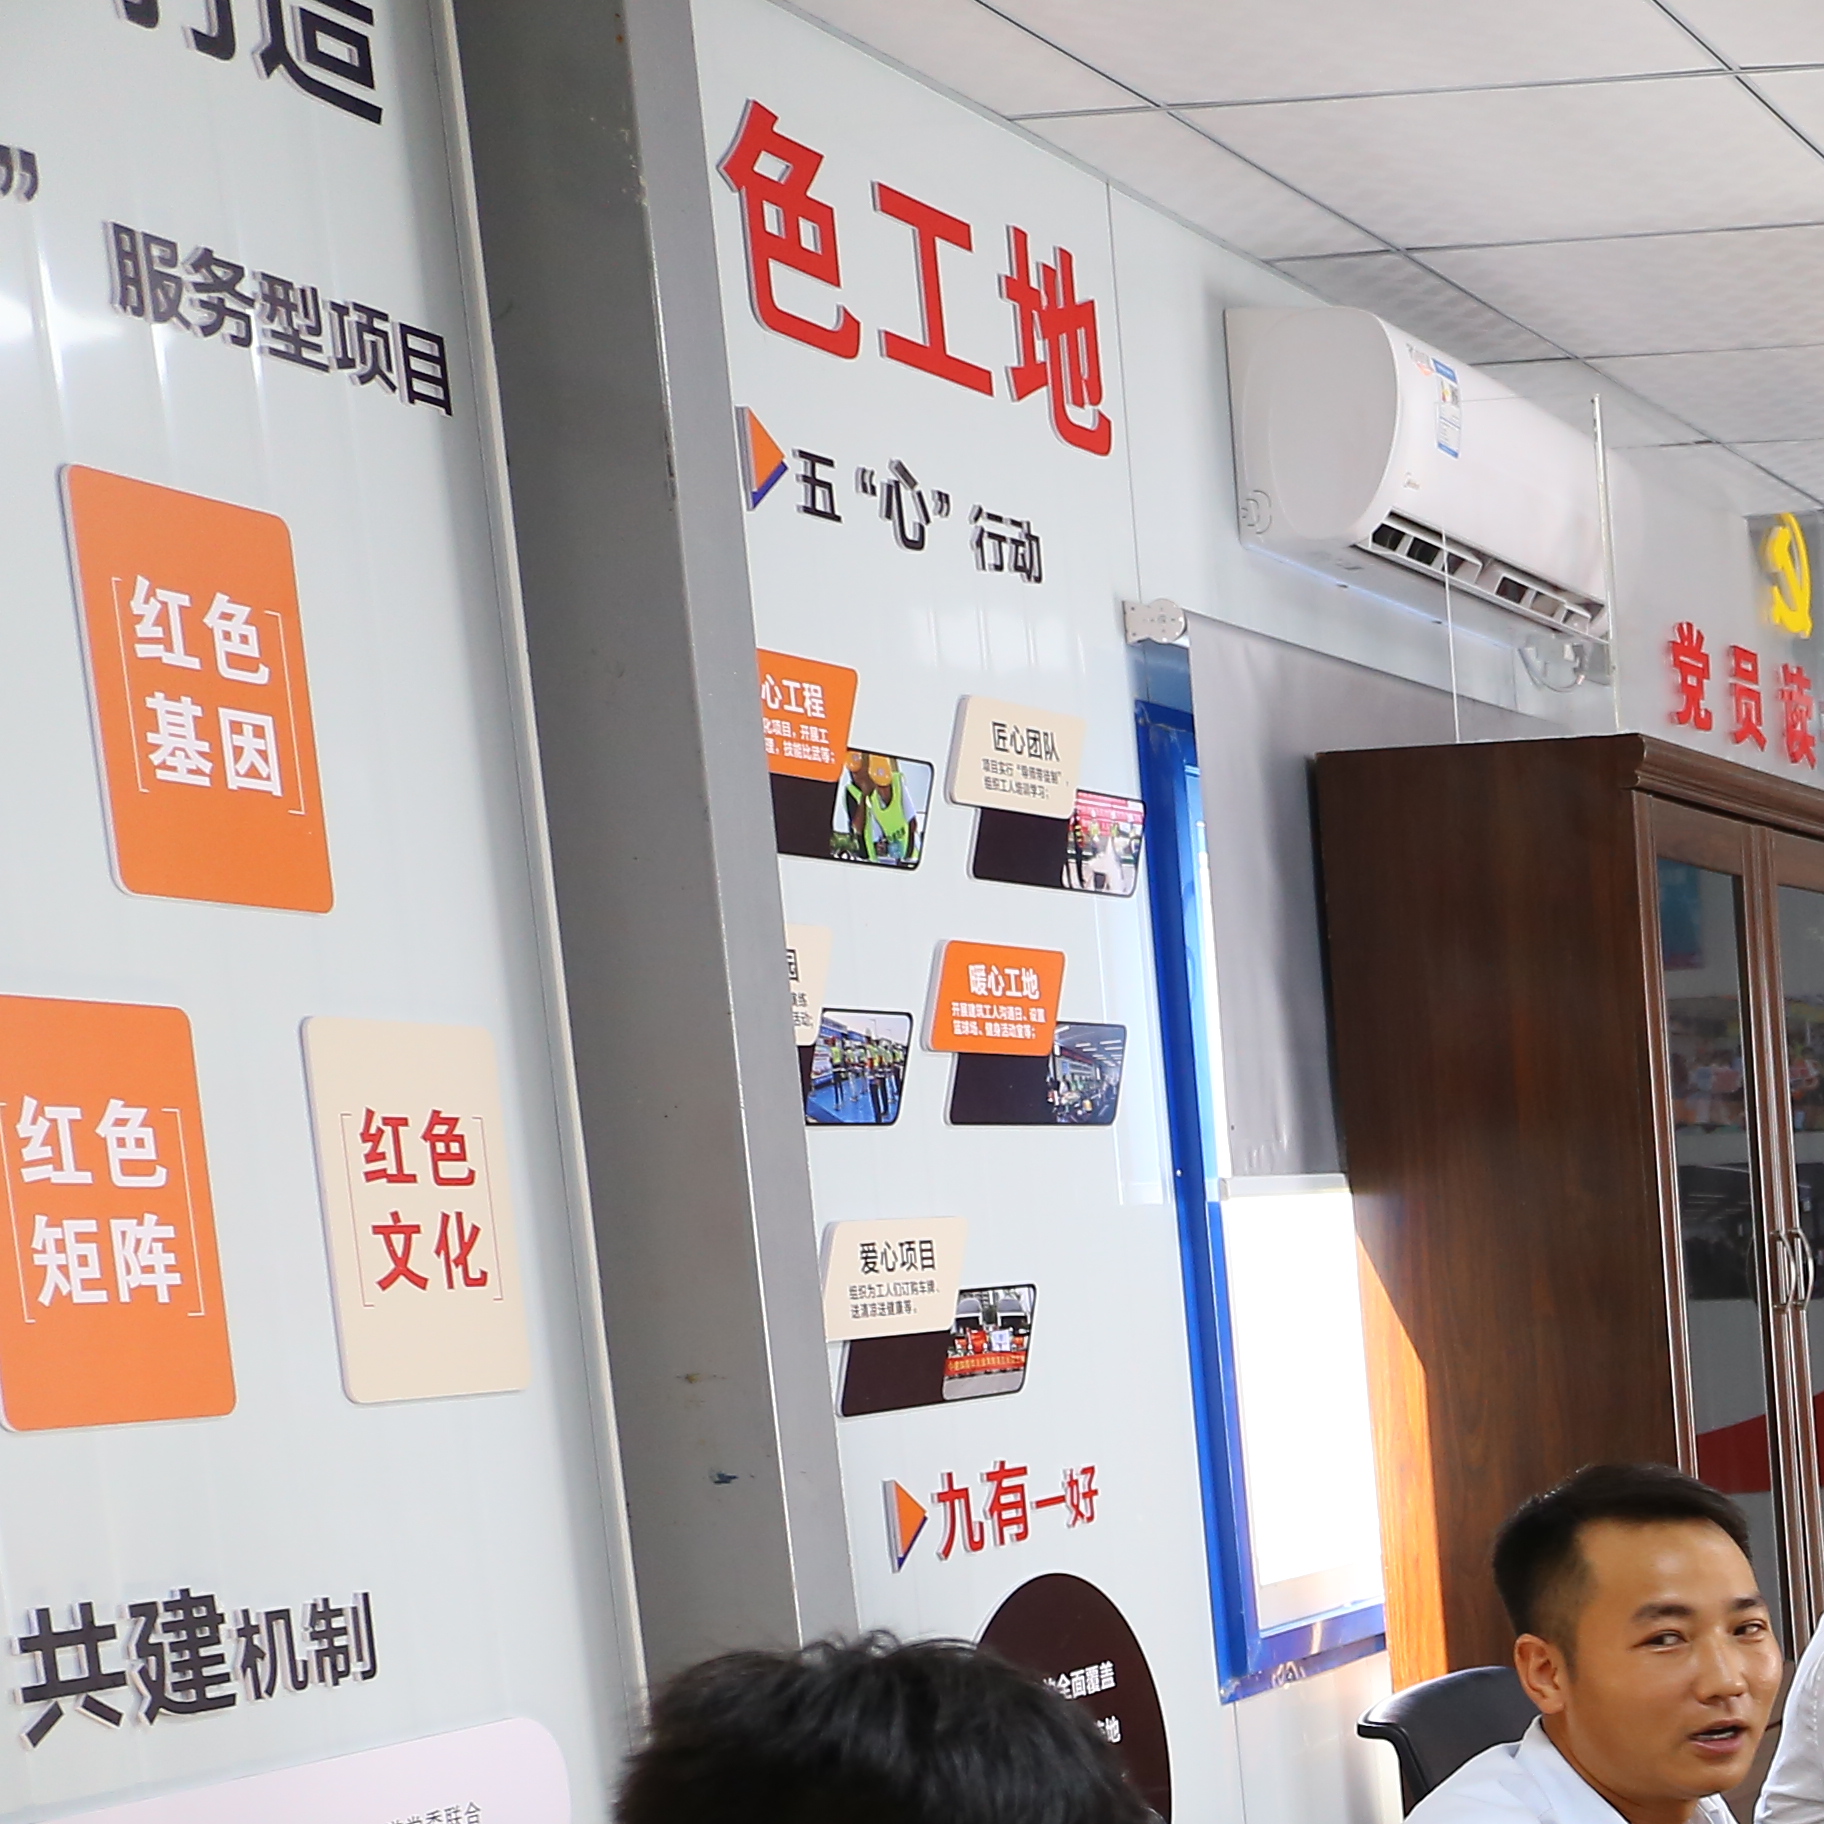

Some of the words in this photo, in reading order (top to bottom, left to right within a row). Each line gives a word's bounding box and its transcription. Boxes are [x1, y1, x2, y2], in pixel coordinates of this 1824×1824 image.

[104, 221, 453, 416] 服务型项目
[717, 98, 1111, 456] 色工地
[131, 575, 270, 685] 红色
[761, 673, 827, 719] 心工程
[991, 721, 1060, 762] 匠心团队
[144, 690, 284, 797] 基因
[967, 963, 1041, 1000] 暖心工地
[15, 1095, 168, 1189] 红色
[359, 1107, 477, 1188] 红色
[30, 1212, 183, 1306] 矩阵
[371, 1209, 489, 1293] 文化
[859, 1239, 937, 1276] 爱心项目
[932, 1459, 1099, 1561] 九有一好
[10, 1584, 381, 1752] 共建机制
